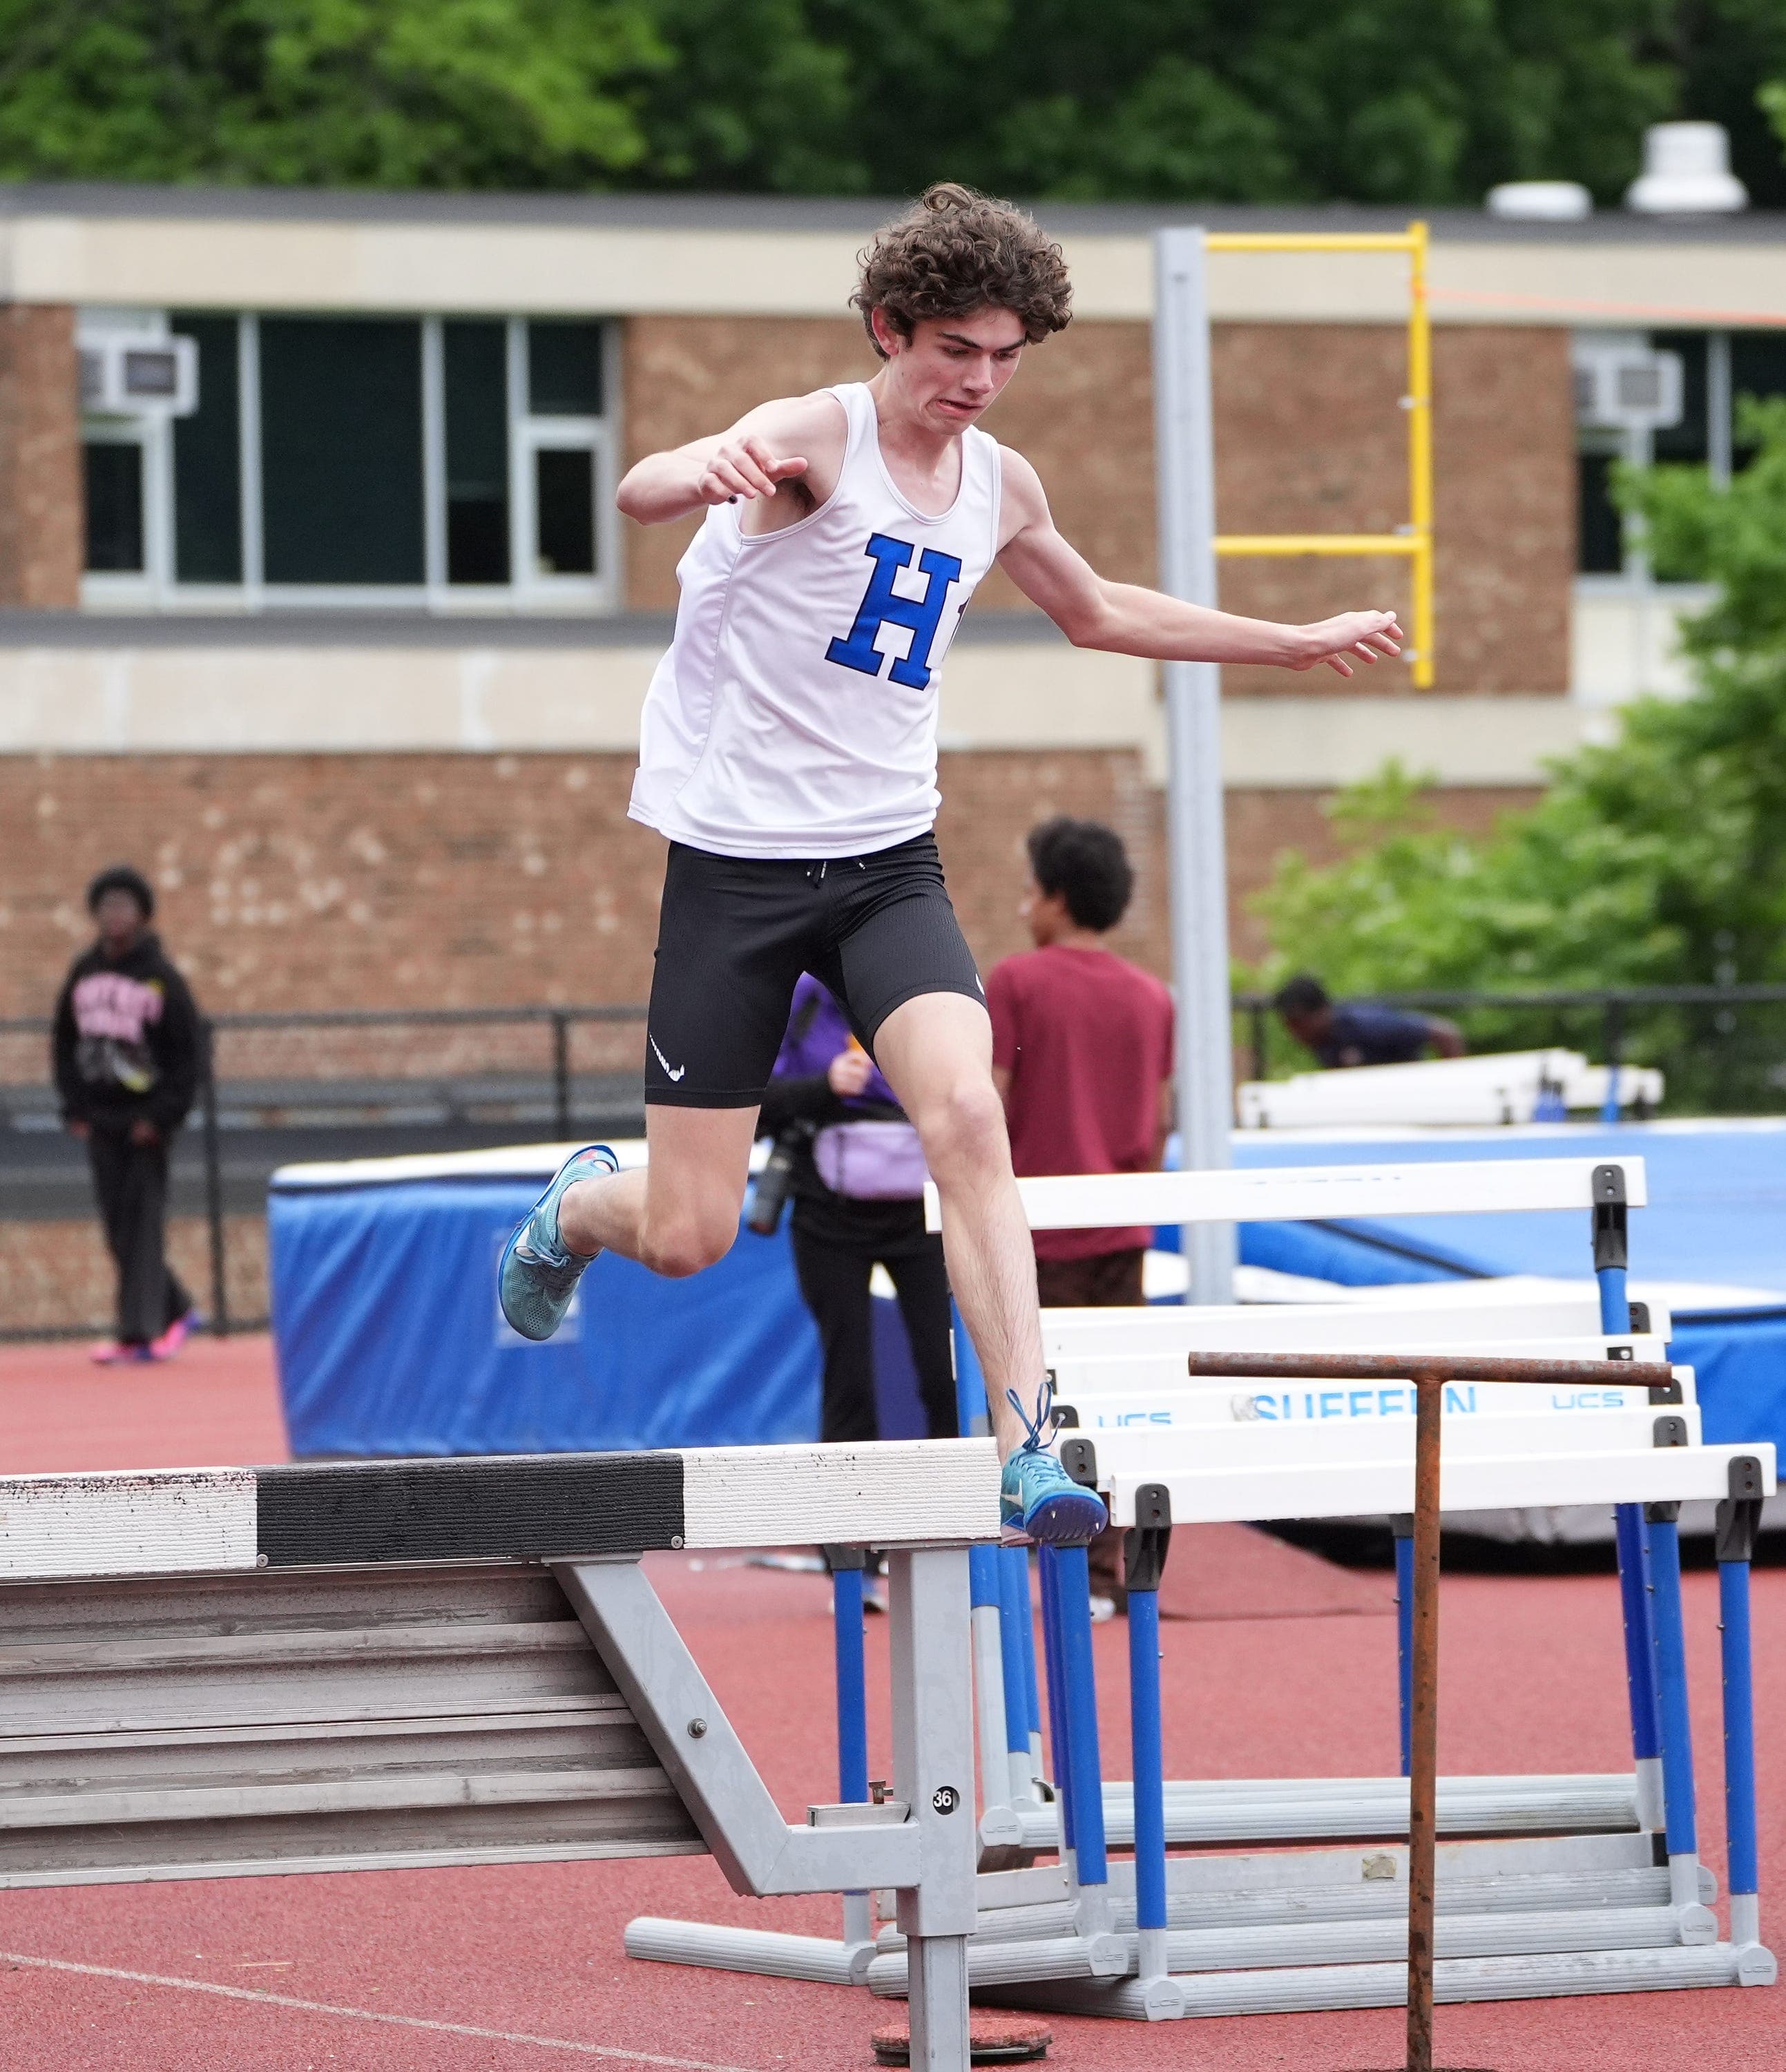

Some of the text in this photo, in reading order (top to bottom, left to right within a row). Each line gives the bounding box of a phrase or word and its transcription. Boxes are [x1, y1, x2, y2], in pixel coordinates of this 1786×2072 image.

[824, 532, 962, 691] H
[1253, 1386, 1476, 1420] SUFFEN
[1551, 1391, 1624, 1410] UCS
[932, 1790, 952, 1807] 36
